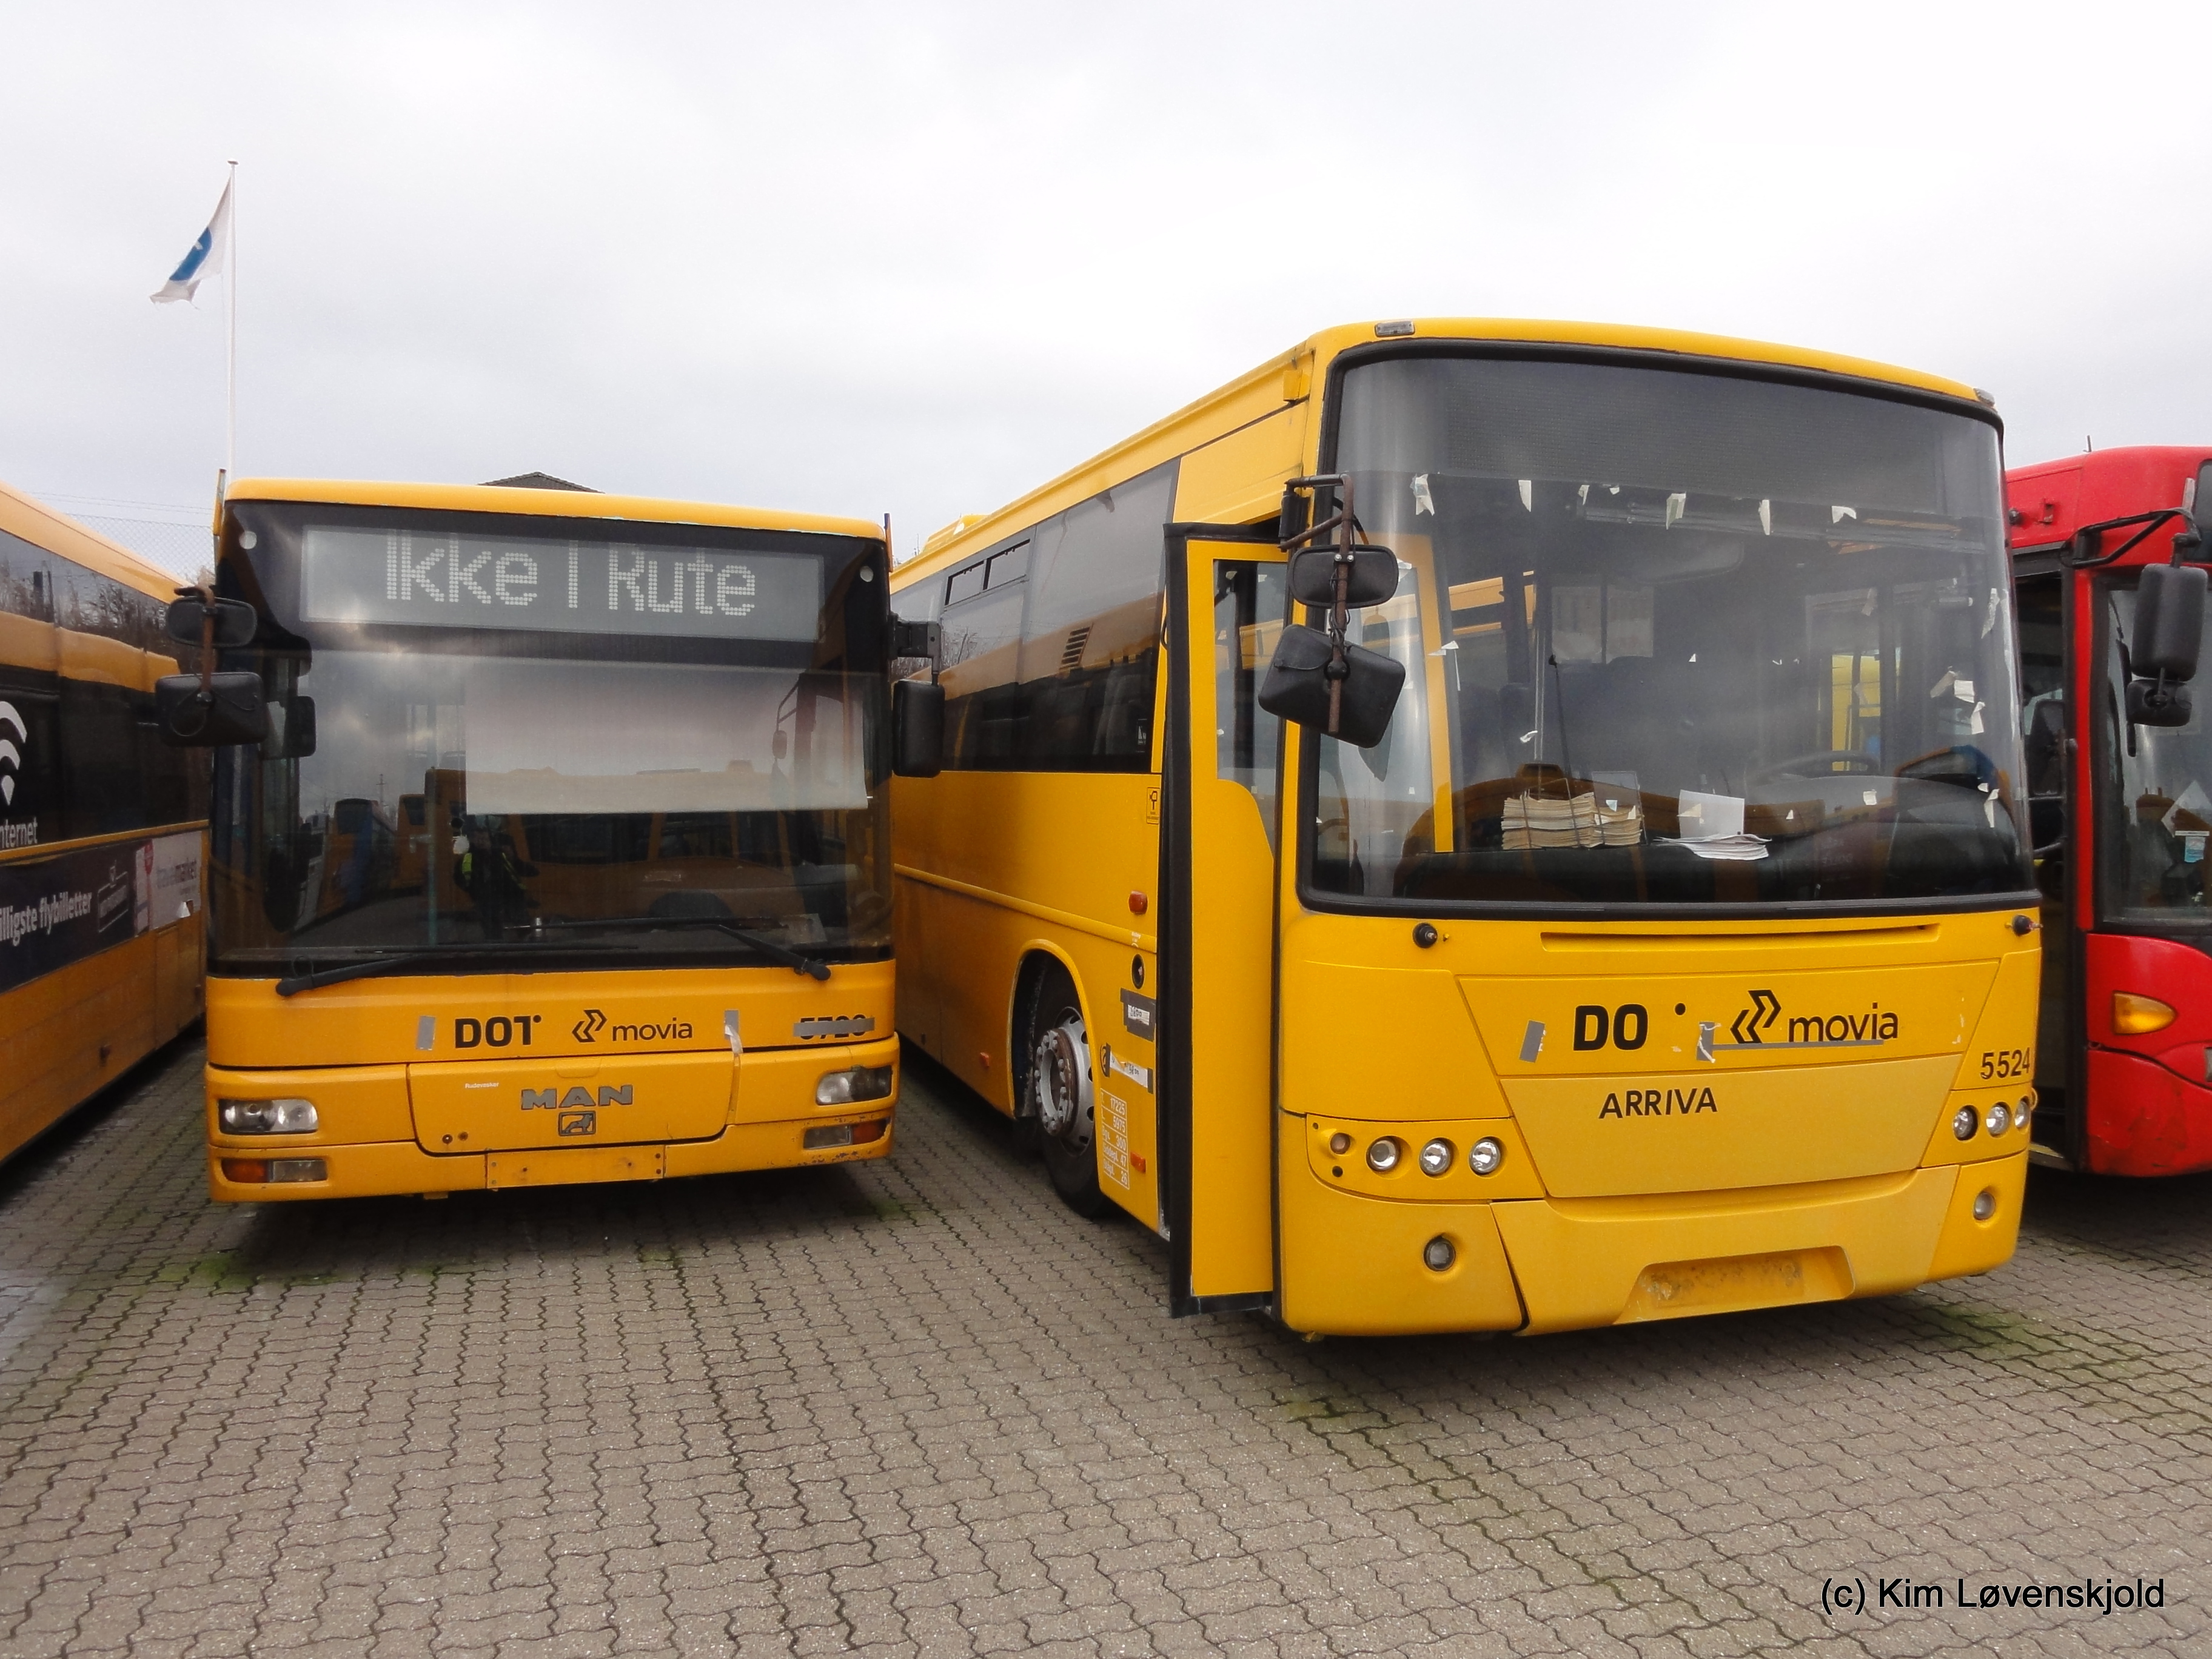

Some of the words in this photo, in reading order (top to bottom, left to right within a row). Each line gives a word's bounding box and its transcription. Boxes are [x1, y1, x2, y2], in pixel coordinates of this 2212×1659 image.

[387, 529, 538, 606] Ikke
[608, 540, 756, 616] Rute
[39, 891, 92, 934] flybilletter
[455, 1015, 536, 1048] DOT
[612, 1017, 693, 1042] movia
[1788, 1002, 1899, 1042] movia
[1980, 1047, 2030, 1080] 5524
[521, 1085, 633, 1110] MAN
[1110, 1097, 1125, 1116] 17225
[1598, 1087, 1718, 1119] ARRIVA
[1113, 1115, 1126, 1134] 5975
[1116, 1134, 1126, 1151] 300
[1120, 1155, 1127, 1167] 47
[1121, 1170, 1128, 1185] 26
